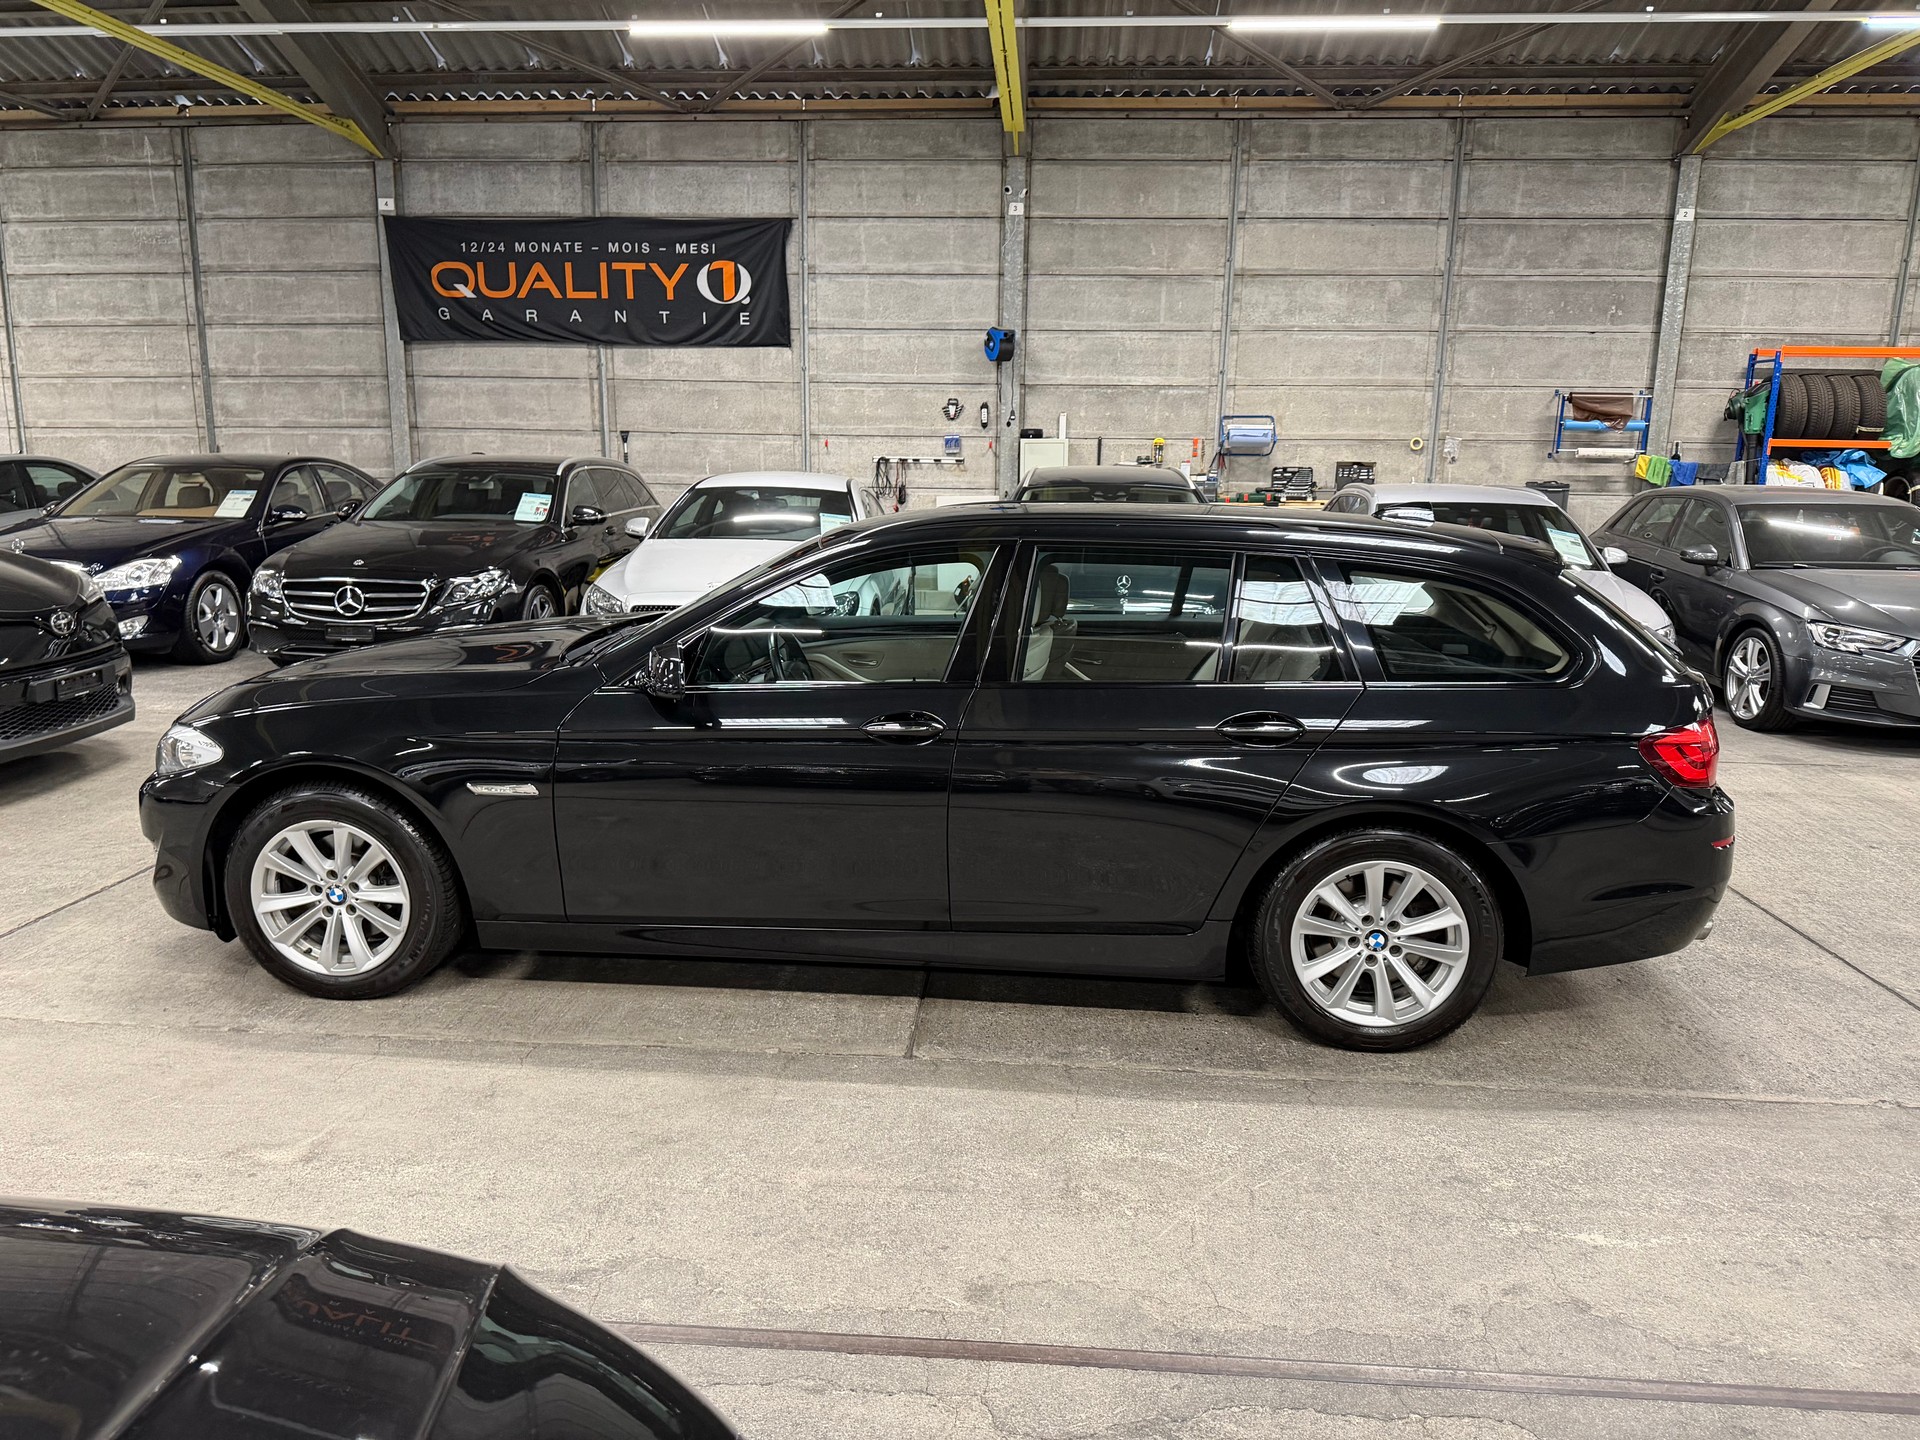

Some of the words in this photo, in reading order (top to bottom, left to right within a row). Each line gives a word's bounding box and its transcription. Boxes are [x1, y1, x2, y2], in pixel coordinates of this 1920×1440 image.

[460, 241, 506, 253] 12/24
[514, 241, 583, 253] MONATE
[607, 242, 651, 254] MOIS
[675, 243, 717, 255] MESI
[430, 261, 690, 302] QUALITY
[437, 307, 751, 326] GARANTIE
